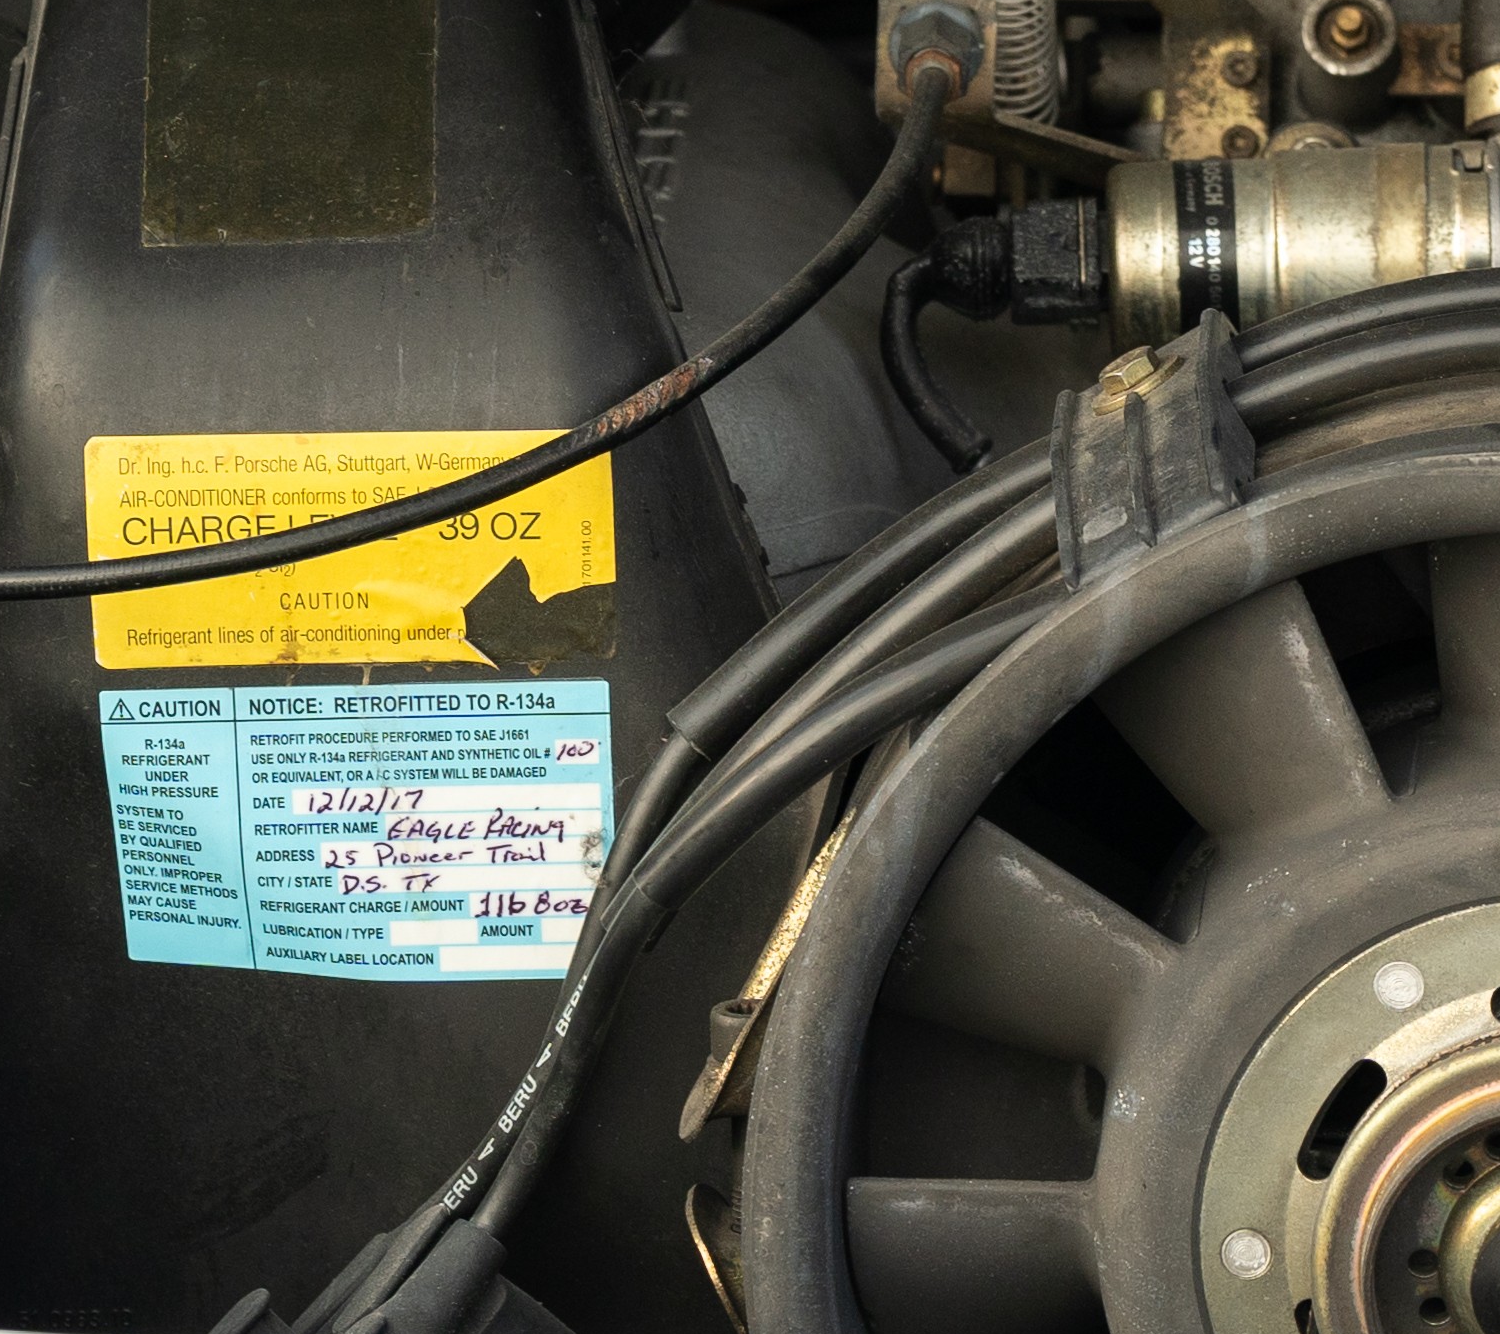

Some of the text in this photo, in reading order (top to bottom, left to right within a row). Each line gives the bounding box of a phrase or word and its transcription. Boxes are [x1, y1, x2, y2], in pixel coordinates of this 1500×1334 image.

[1188, 236, 1205, 268] 12V
[119, 457, 140, 474] Dr.
[147, 456, 174, 478] Ing.
[182, 456, 208, 473] h.c.
[235, 455, 296, 473] Porsche
[303, 454, 330, 474] AG,
[337, 453, 410, 475] Stuttgart,
[120, 488, 265, 507] AIR-CONDITIONER
[272, 487, 345, 505] conforms
[352, 488, 366, 504] to
[122, 515, 276, 546] CHARGE
[438, 511, 540, 540] 39 OZ
[280, 591, 368, 610] CAUTION
[127, 627, 212, 648] Refrigerant
[218, 626, 254, 643] lines
[260, 625, 274, 643] of
[280, 624, 400, 644] air-conditioning
[407, 624, 451, 640] under
[139, 699, 220, 717] CAUTION
[249, 692, 554, 715] NOTICE: RETROFITTED TO R-134a
[144, 738, 184, 749] R-134a
[250, 729, 528, 745] RETROFIT PROCEDURE PERFORMED TO SAE J1661
[122, 754, 210, 766] REFRIGERANT
[251, 747, 541, 764] USE ONLY R-134a REFRIGERANT AND SYNTHETIC OIL
[145, 770, 188, 782] UNDER
[252, 772, 268, 783] OR
[272, 770, 343, 783] EQUIVALENT,
[346, 770, 362, 781] OR
[394, 768, 439, 780] SYSTEM
[442, 767, 470, 779] WILL
[472, 767, 486, 778] BE
[490, 766, 546, 778] DAMAGED
[119, 783, 218, 798] HIGH PRESSURE
[253, 796, 284, 809] DATE
[308, 786, 424, 814] 12/12/17
[116, 803, 183, 820] SYSTEM TO
[118, 818, 196, 836] BE SERVICED
[254, 821, 378, 835] RETROFITTER NAME
[387, 816, 476, 844] EAGLE
[120, 833, 201, 851] BY QUALIFIED
[122, 848, 194, 866] PERSONNEL
[256, 849, 314, 861] ADDRESS
[325, 849, 359, 869] 25
[487, 841, 547, 864] Trail
[124, 864, 222, 883] ONLY. IMPROPER
[257, 875, 332, 887] CITY STATE
[126, 879, 238, 899] SERVICE METHODS
[127, 894, 196, 909] MAY CAUSE
[260, 899, 464, 913] REFRIGERANT CHARGE AMOUNT
[129, 909, 241, 929] PERSONAL INJURY.
[262, 923, 383, 939] LUBRICATION TYPE
[480, 924, 533, 936] AMOUNT
[266, 946, 433, 965] AUXILIARY LABEL LOCATION
[498, 1073, 537, 1133] BERU
[443, 1165, 479, 1210] ERU
